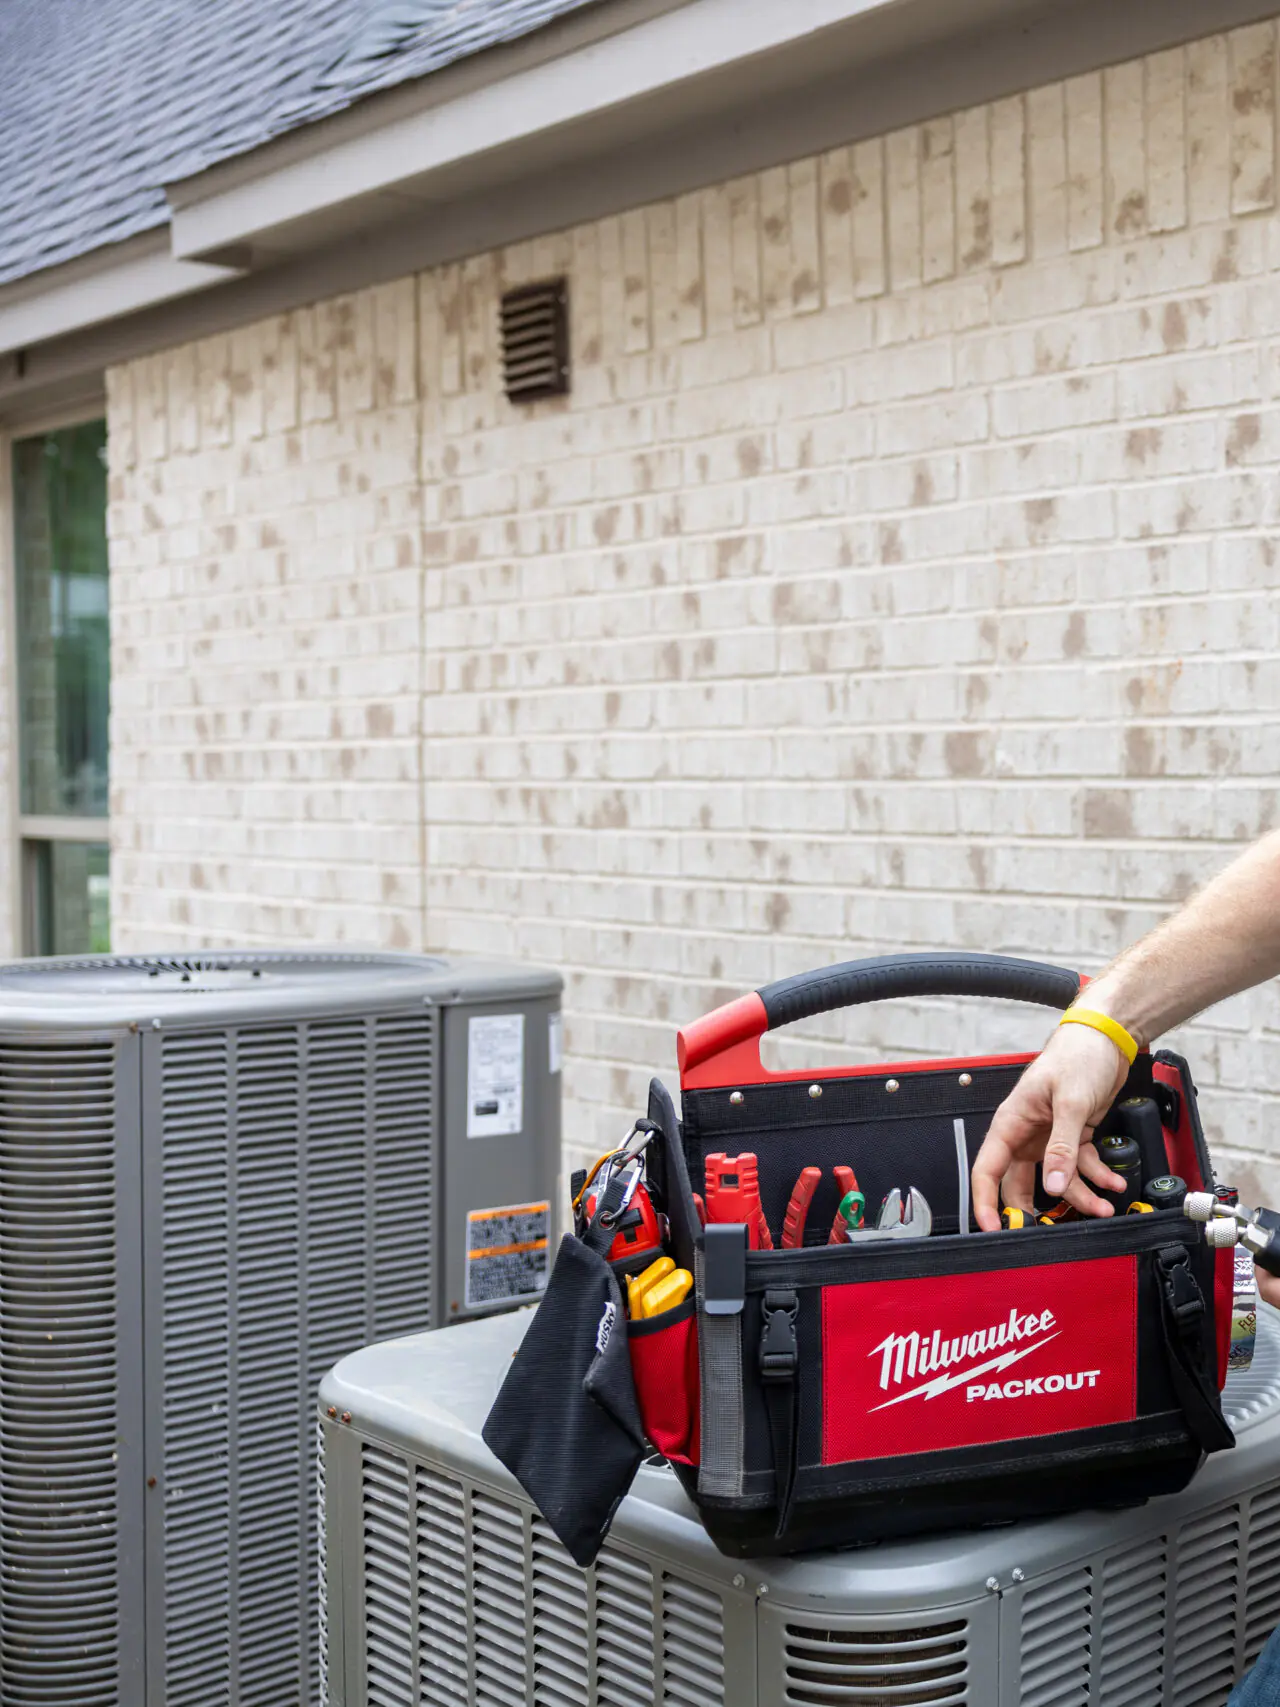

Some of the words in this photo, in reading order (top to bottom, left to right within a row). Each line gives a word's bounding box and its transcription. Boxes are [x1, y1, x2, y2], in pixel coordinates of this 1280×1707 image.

[600, 1308, 615, 1350] HUSKY
[867, 1308, 1057, 1390] Milwaukee
[966, 1369, 1101, 1402] PACKOUT
